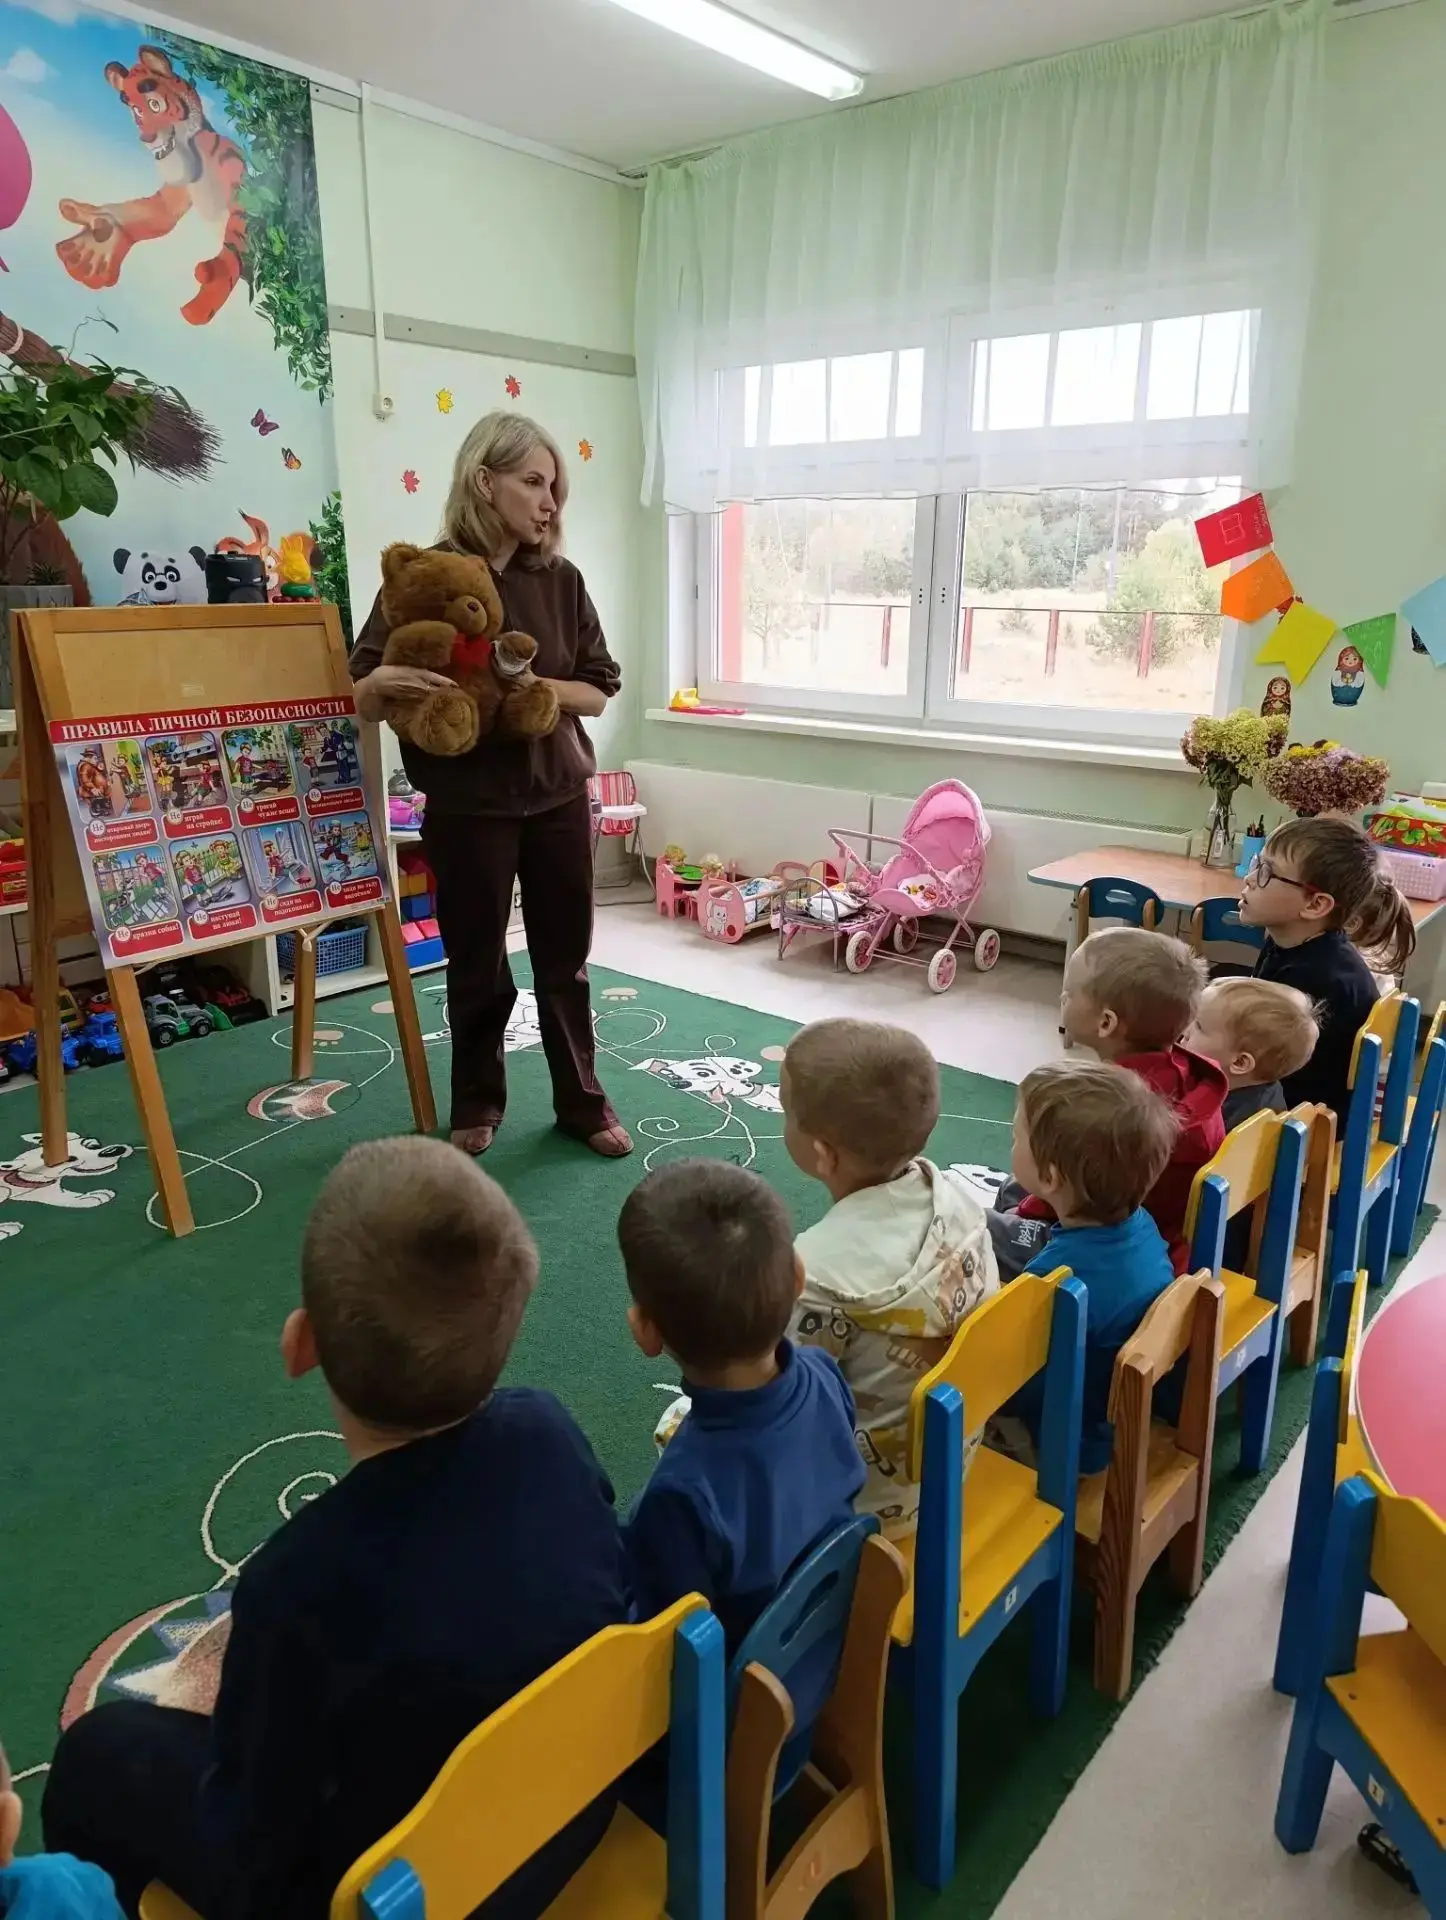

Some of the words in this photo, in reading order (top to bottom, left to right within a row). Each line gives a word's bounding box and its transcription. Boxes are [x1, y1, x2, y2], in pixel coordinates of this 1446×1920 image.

[61, 717, 146, 740] ПРАВИЛА
[149, 710, 222, 732] ЛИЧНОЙ
[225, 701, 346, 724] БЕЗОПАСНОСТИ
[92, 823, 105, 832] Не
